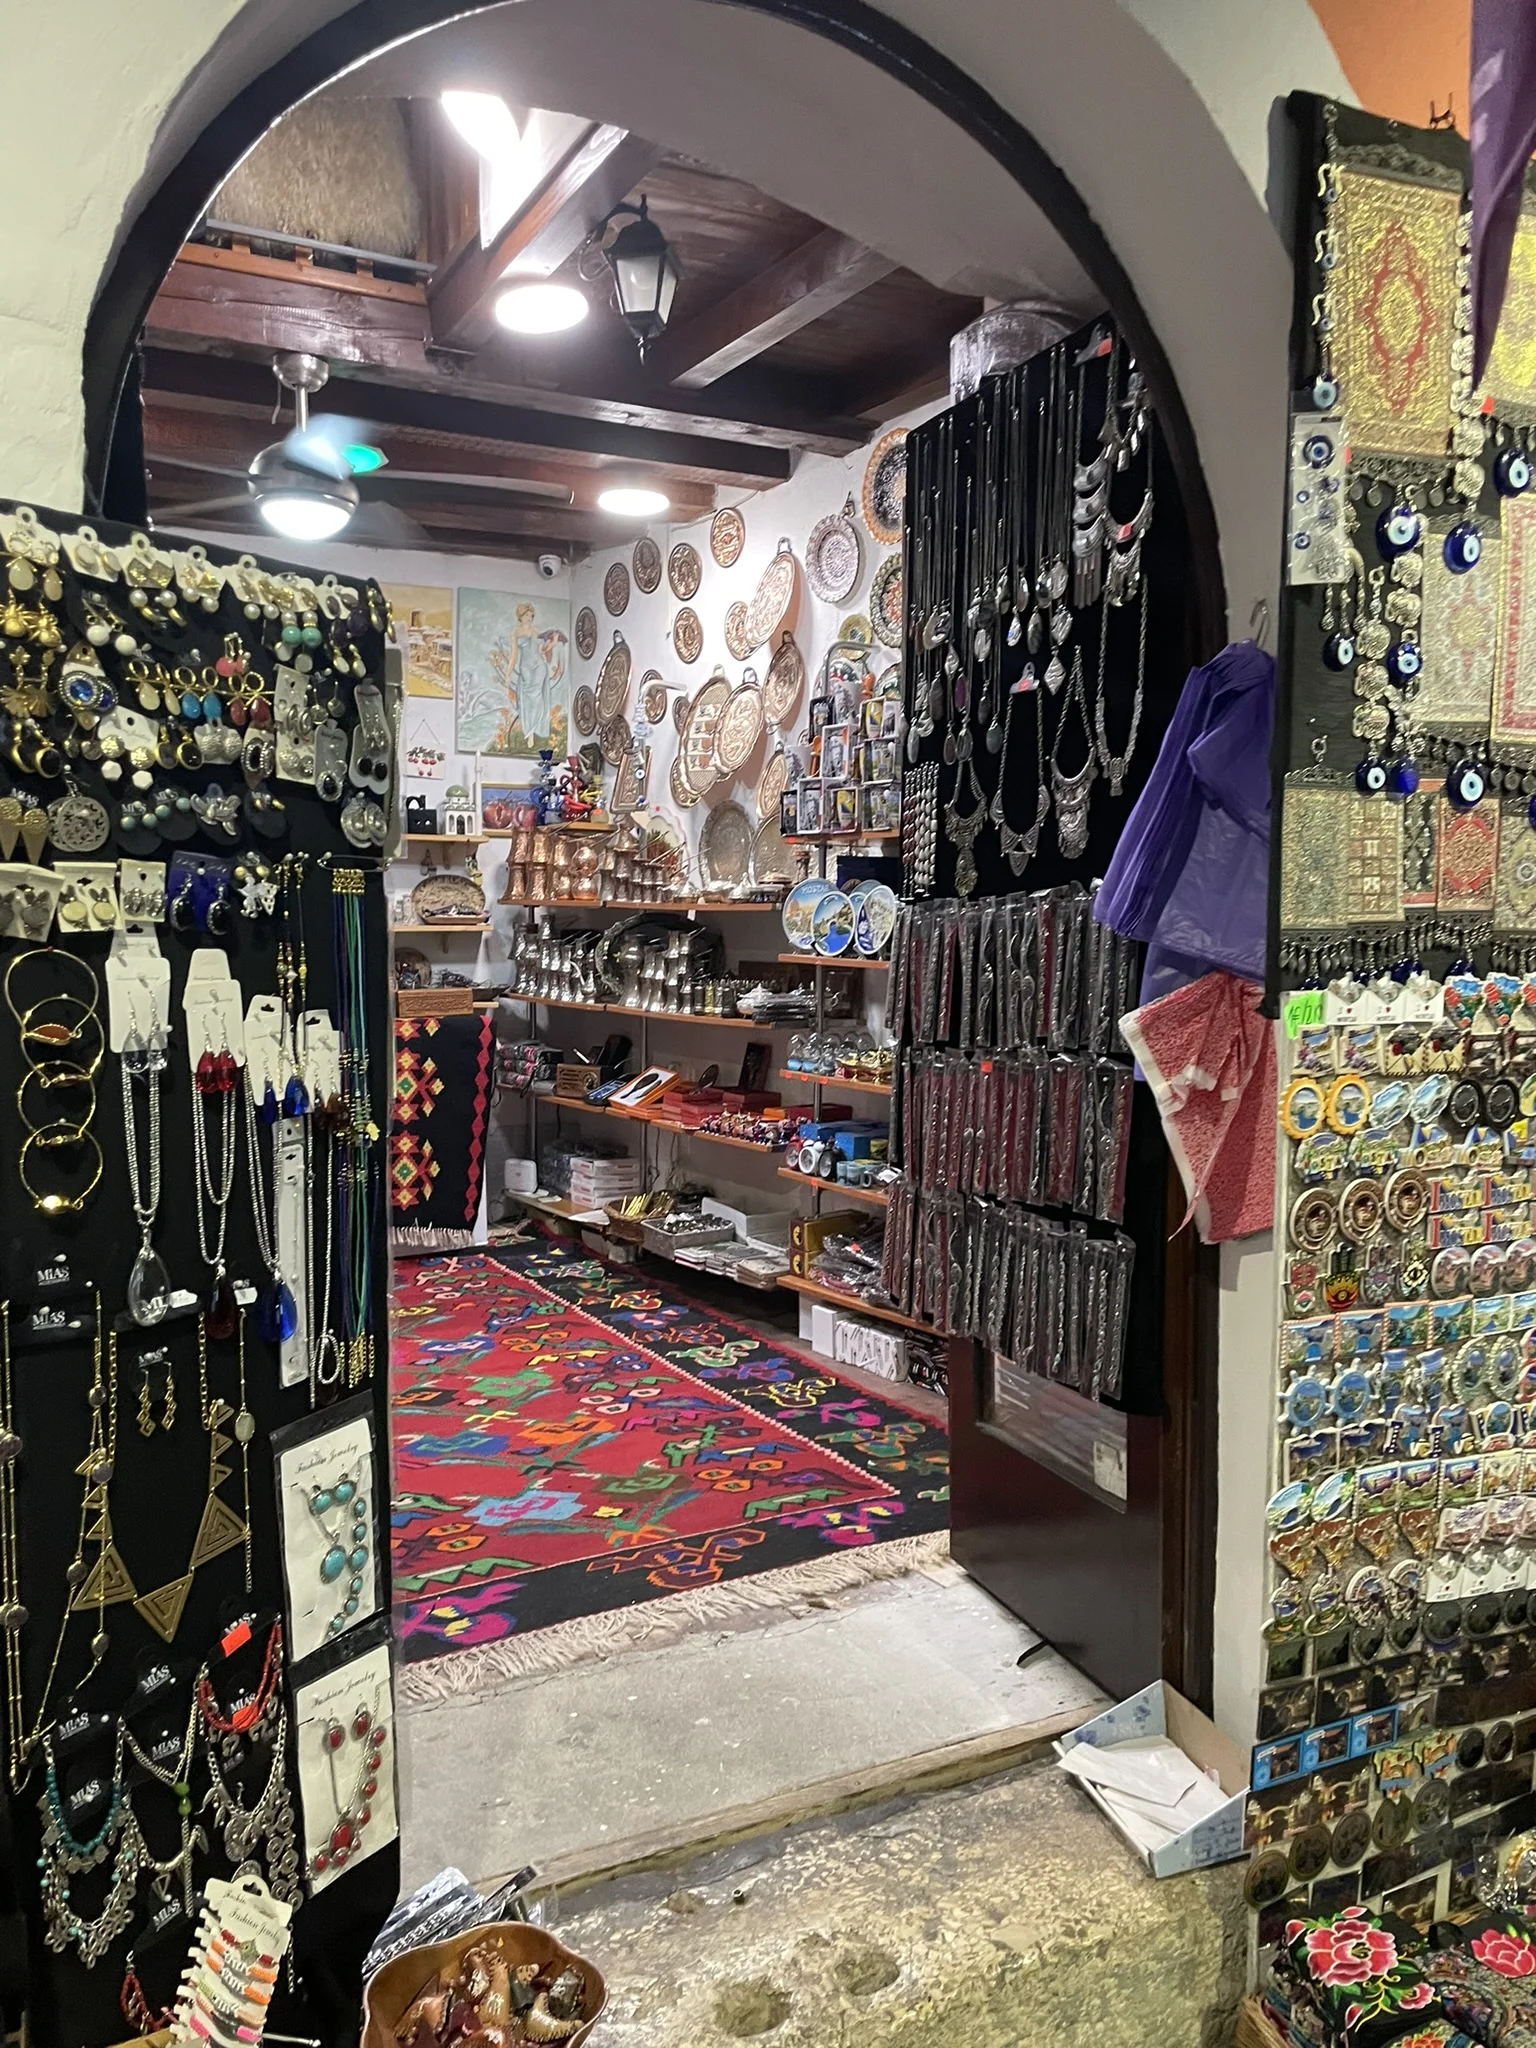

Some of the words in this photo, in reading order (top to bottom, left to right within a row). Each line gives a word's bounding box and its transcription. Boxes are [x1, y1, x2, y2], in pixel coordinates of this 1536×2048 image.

[121, 803, 147, 815] MIS
[37, 1266, 70, 1282] MIAS
[141, 1665, 170, 1691] MIAS
[59, 1712, 90, 1736] MIAS
[152, 1736, 181, 1757] MIAS
[70, 1780, 100, 1805] MIAS
[152, 1899, 182, 1927] MIAS
